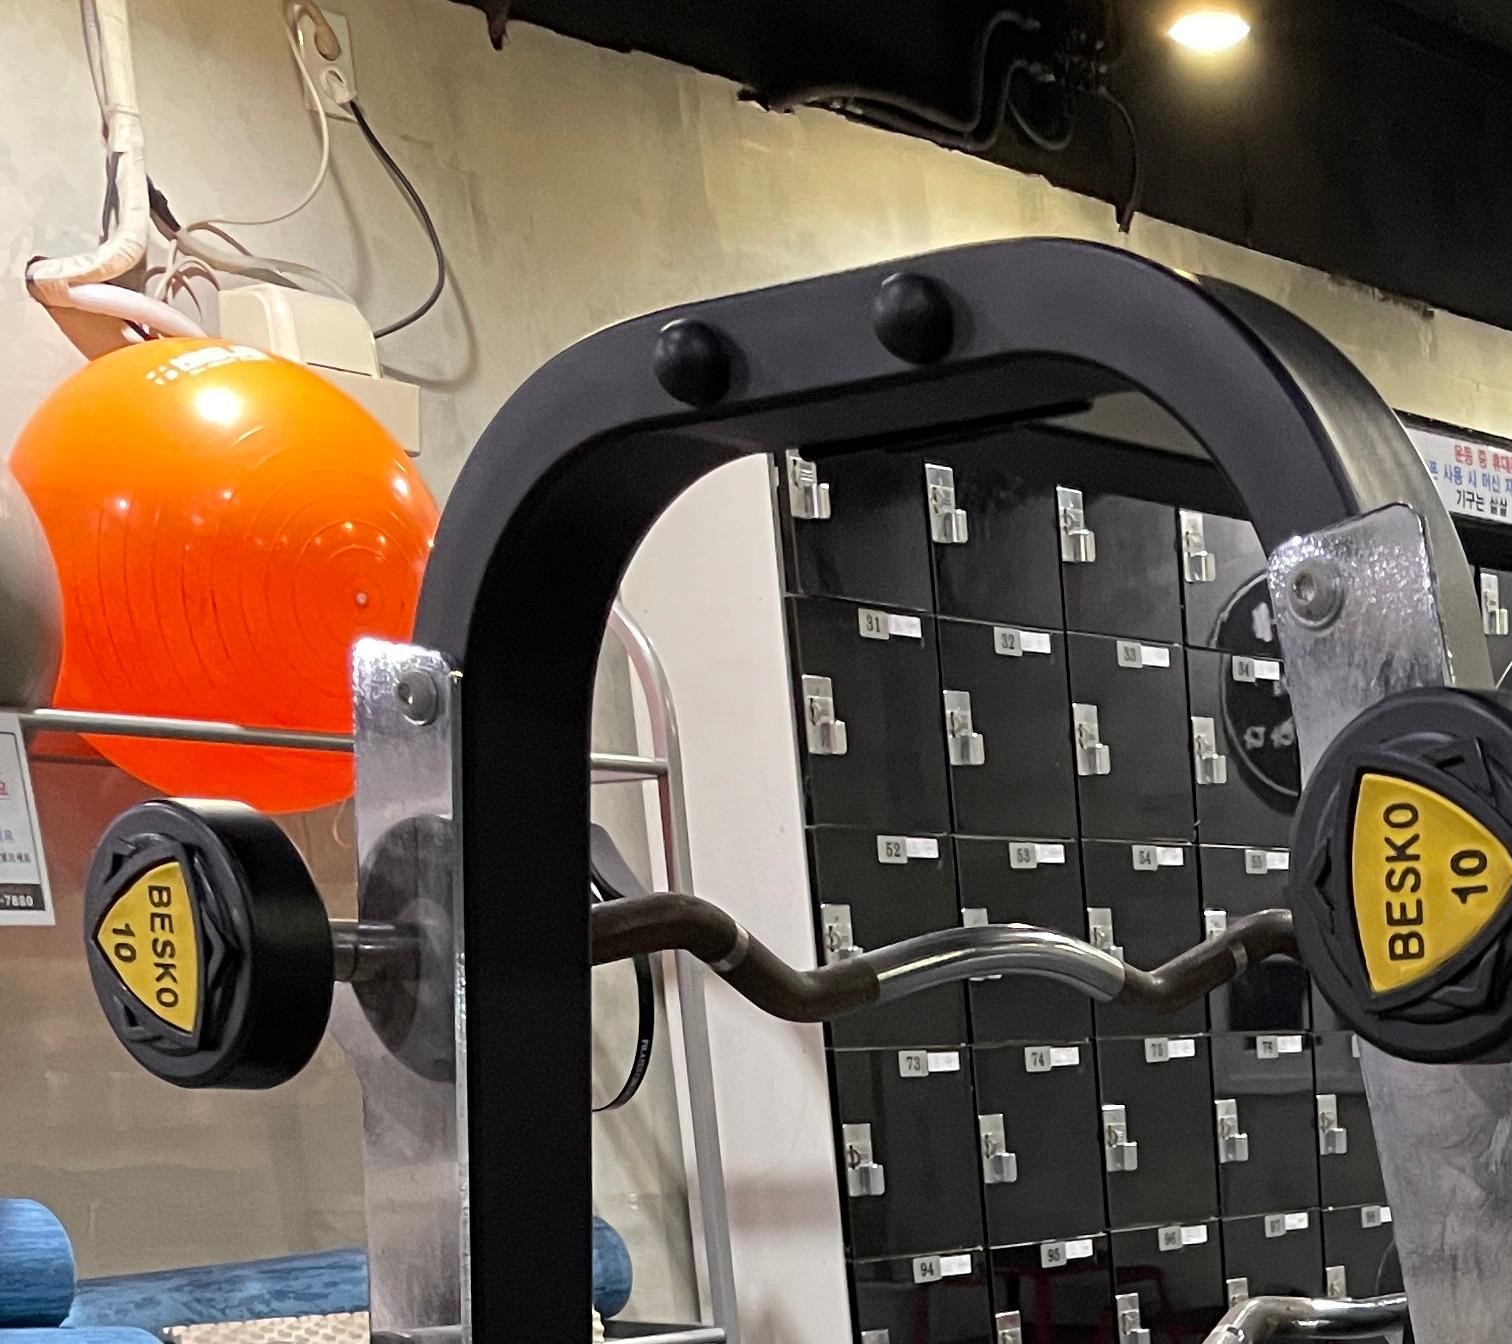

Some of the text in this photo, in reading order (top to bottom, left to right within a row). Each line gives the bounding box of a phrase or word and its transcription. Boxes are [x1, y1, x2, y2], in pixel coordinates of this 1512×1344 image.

[1478, 448, 1487, 470] 중
[1456, 489, 1486, 513] 기구는
[865, 613, 882, 633] 31
[885, 841, 902, 858] 52
[1382, 801, 1425, 962] BESKO
[1449, 849, 1489, 905] 10
[111, 922, 137, 964] 10
[147, 885, 180, 1008] BESKO
[905, 1055, 922, 1072] 73
[919, 1261, 935, 1278] 94
